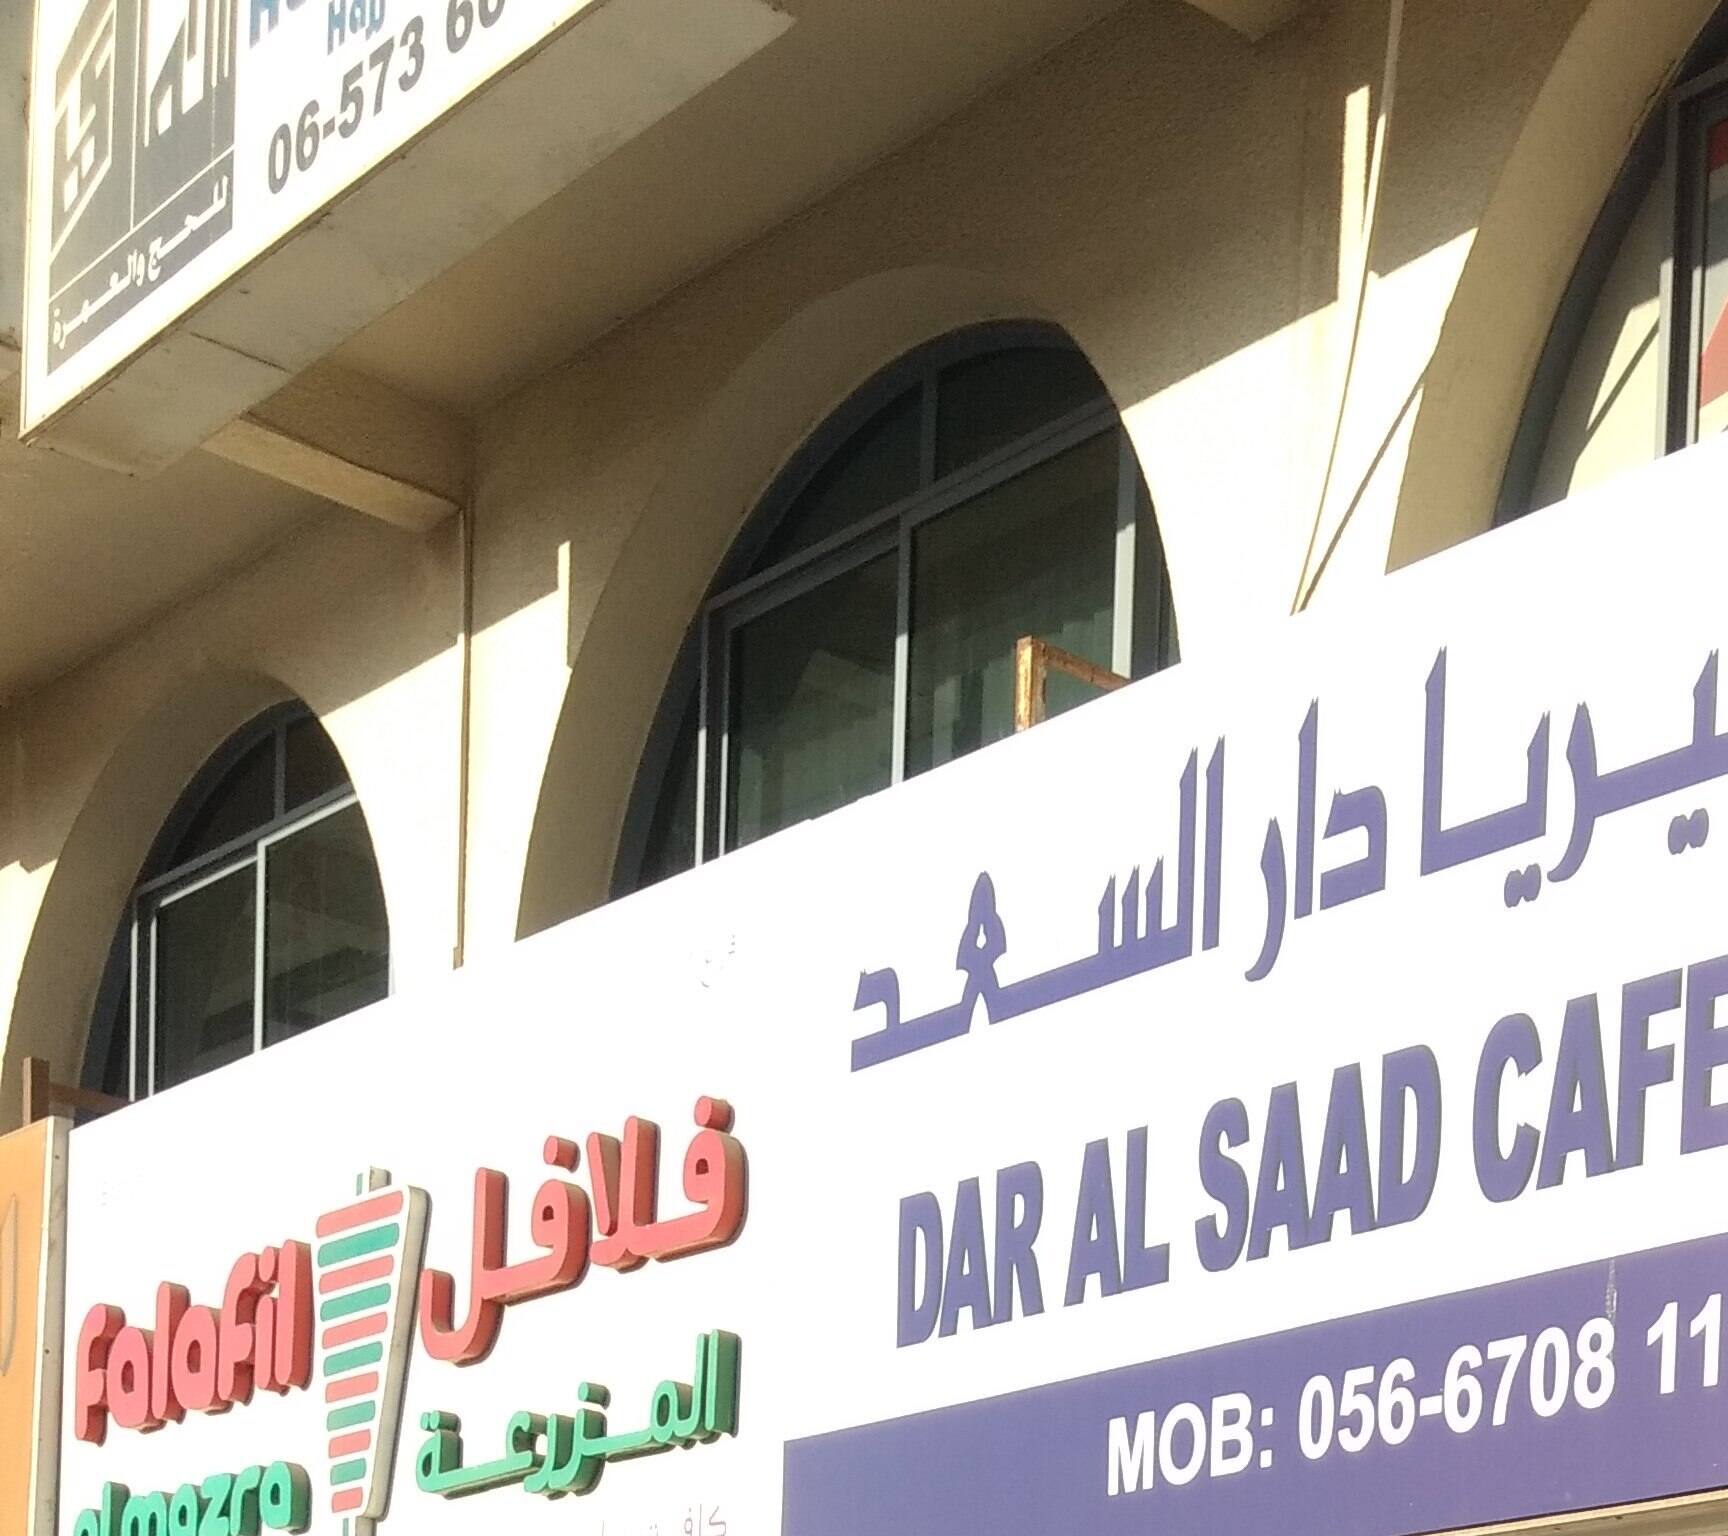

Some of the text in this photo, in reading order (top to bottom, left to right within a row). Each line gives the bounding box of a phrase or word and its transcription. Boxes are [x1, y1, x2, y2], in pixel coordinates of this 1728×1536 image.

[850, 736, 1225, 1072] السعد
[1245, 698, 1388, 982] دار
[420, 1095, 747, 1363] فلافل
[896, 1158, 1045, 1347] DAR
[1065, 1125, 1169, 1314] AL
[1194, 1043, 1442, 1273] SAAD
[415, 1329, 742, 1496] المزرعة
[1106, 1392, 1274, 1497] MOB:
[1297, 1316, 1616, 1461] 056-6708
